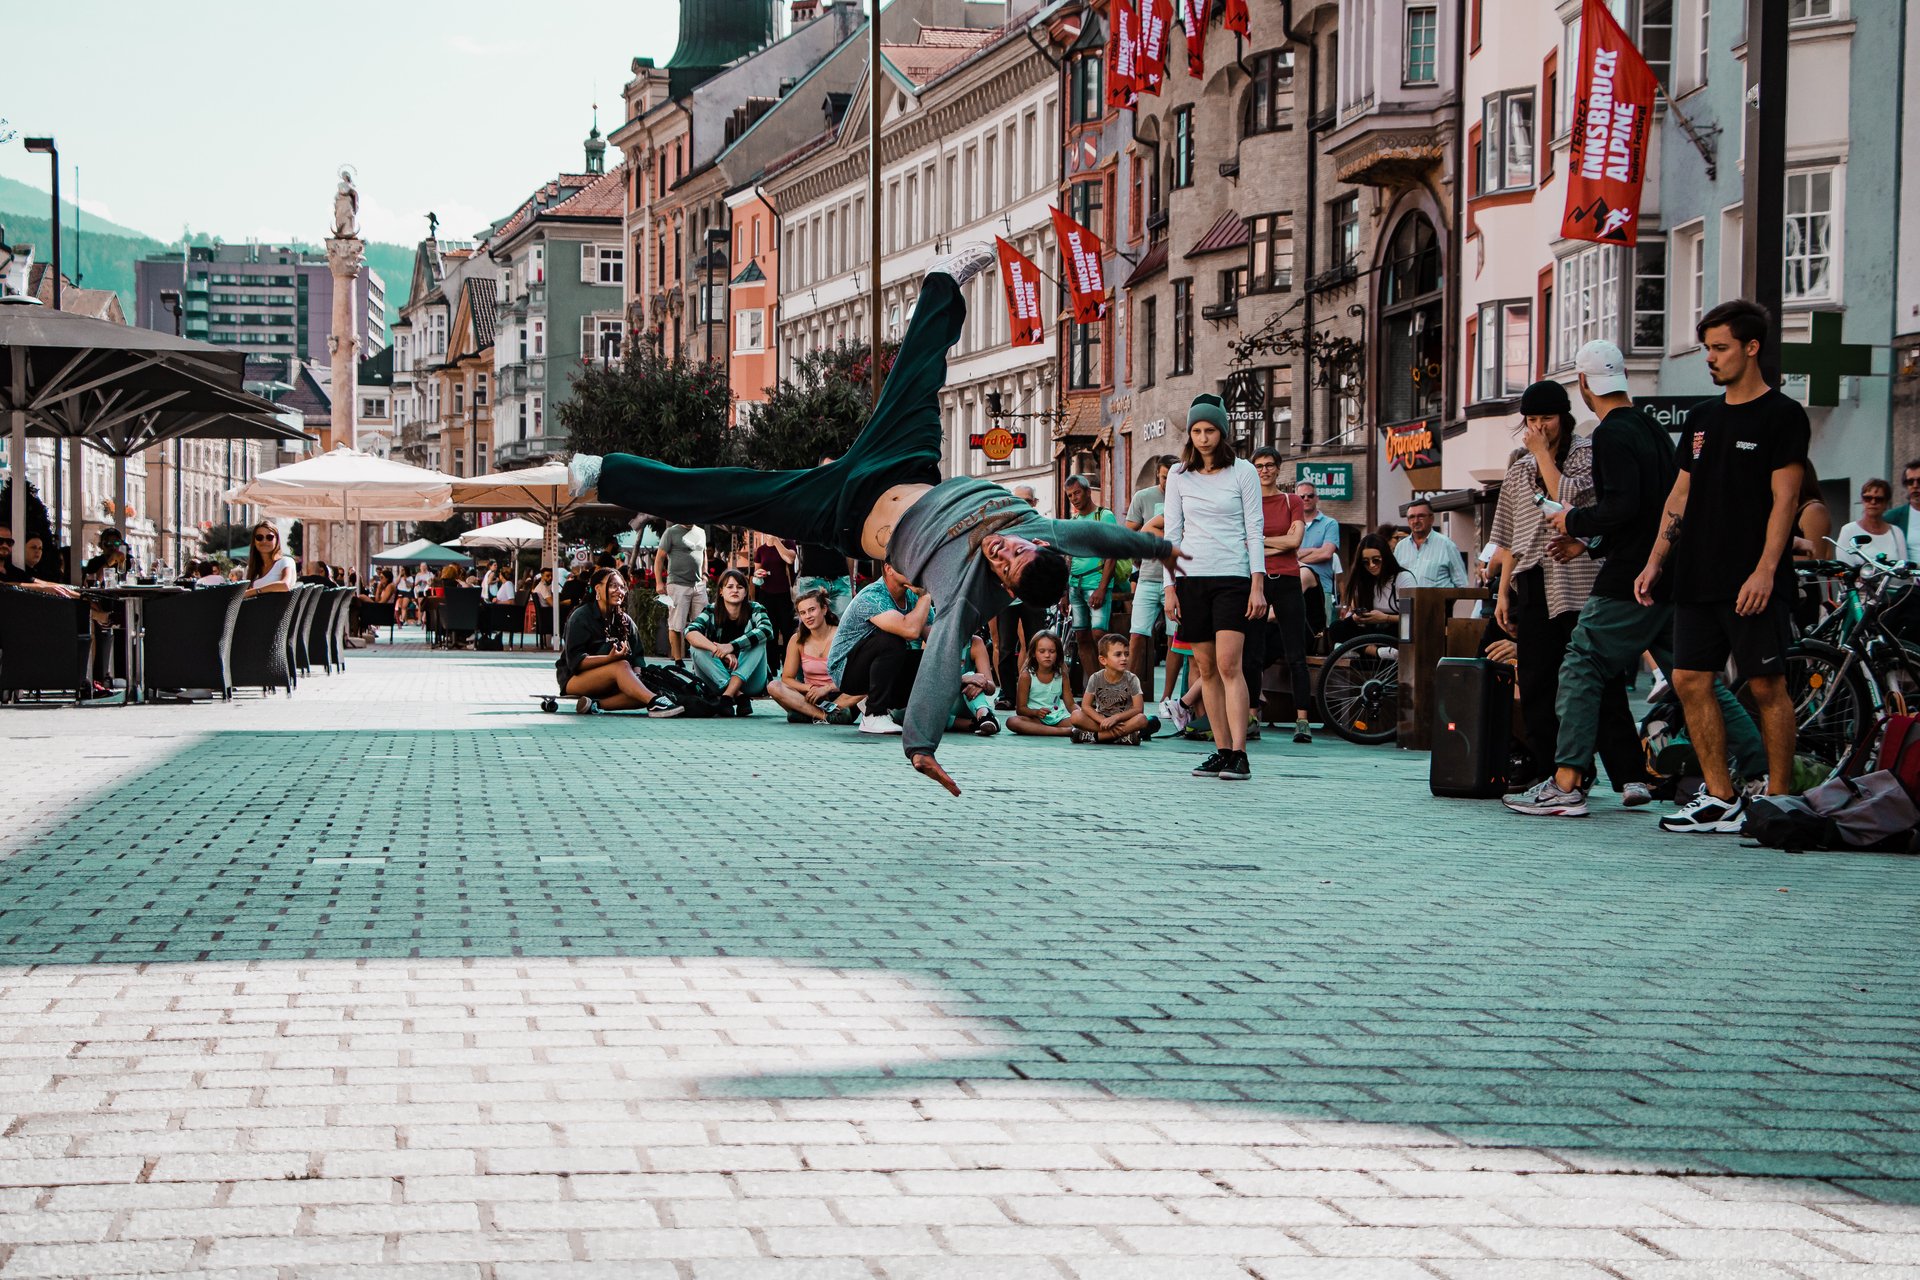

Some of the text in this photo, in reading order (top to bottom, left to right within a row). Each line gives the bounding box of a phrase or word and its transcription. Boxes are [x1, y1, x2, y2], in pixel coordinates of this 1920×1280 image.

[1117, 9, 1128, 76] INNSBRUCK
[1146, 15, 1162, 61] ALPINE
[1570, 97, 1588, 154] TERREX
[1581, 47, 1618, 180] INNSBRUCK
[1634, 105, 1647, 146] Festival
[1605, 101, 1636, 183] ALPINE
[1068, 231, 1091, 294] INNSBRUCK
[1085, 252, 1102, 291] ALPINE
[1009, 261, 1028, 319] INNSBRUCK
[1024, 282, 1037, 318] ALPINE
[1143, 419, 1166, 441] BOGNER
[1226, 411, 1264, 420] STAGE12
[971, 434, 1024, 447] Hard Rock
[1386, 420, 1432, 469] Orangerie
